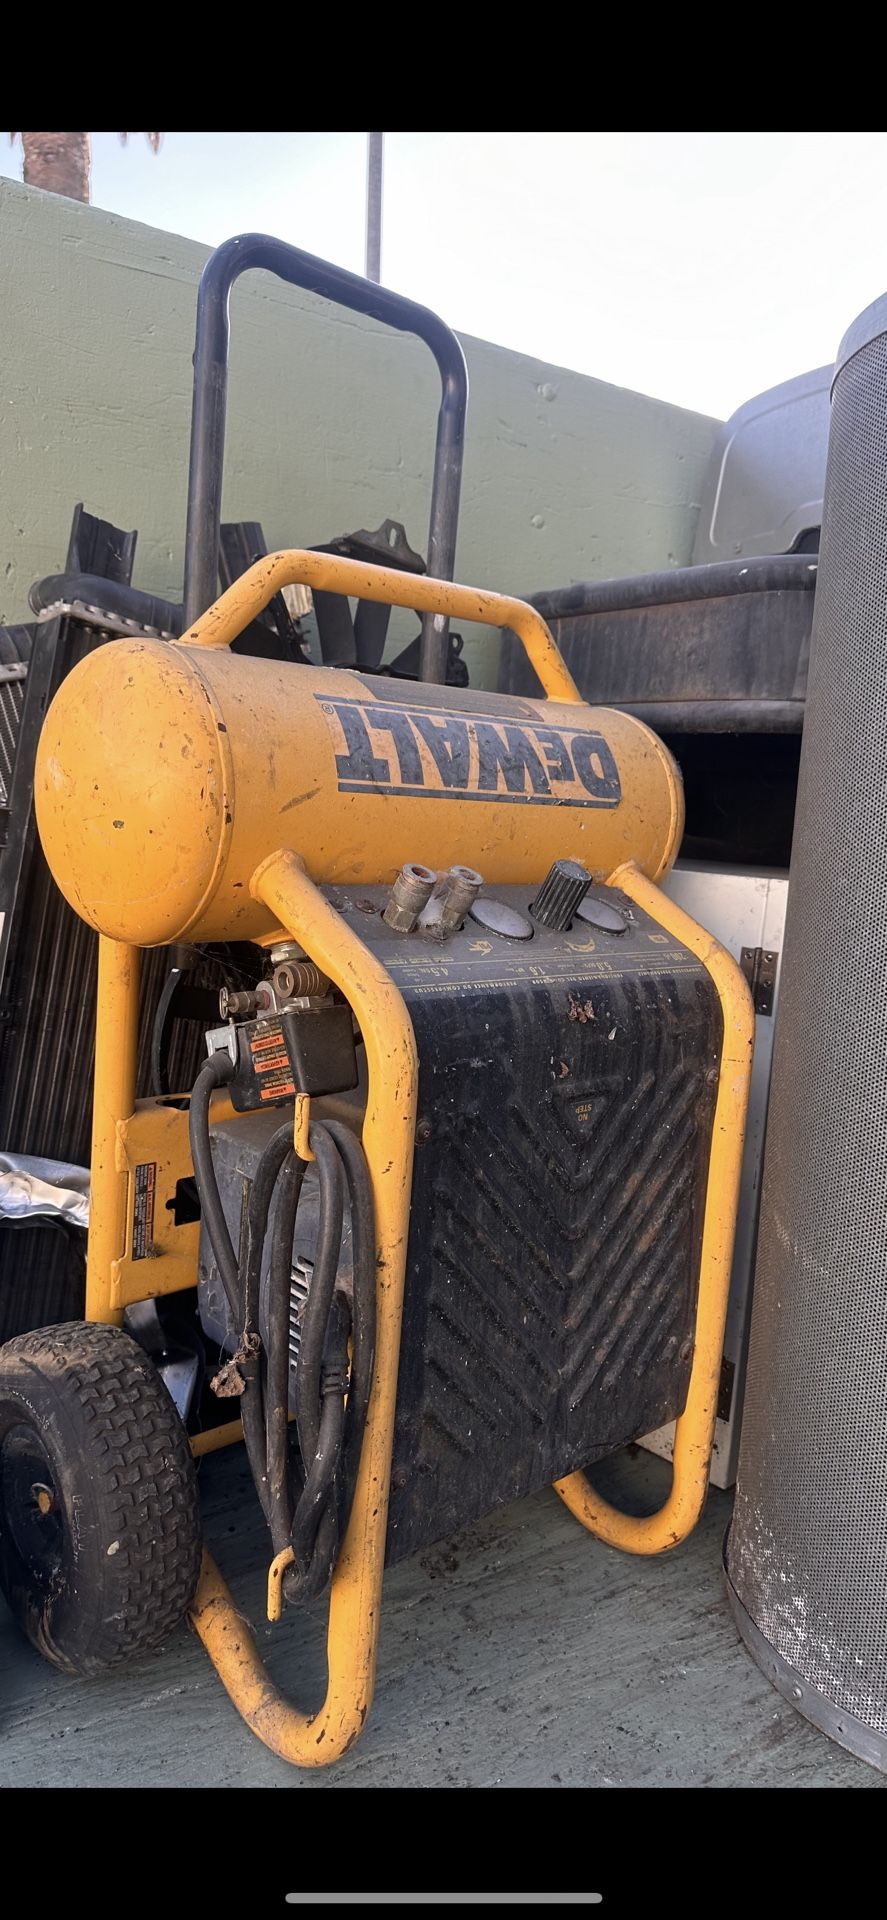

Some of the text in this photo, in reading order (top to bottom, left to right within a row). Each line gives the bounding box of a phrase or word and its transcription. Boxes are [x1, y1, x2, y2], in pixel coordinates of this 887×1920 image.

[334, 704, 622, 799] DEWALT
[576, 1104, 592, 1113] STEP
[578, 1113, 587, 1121] NO
